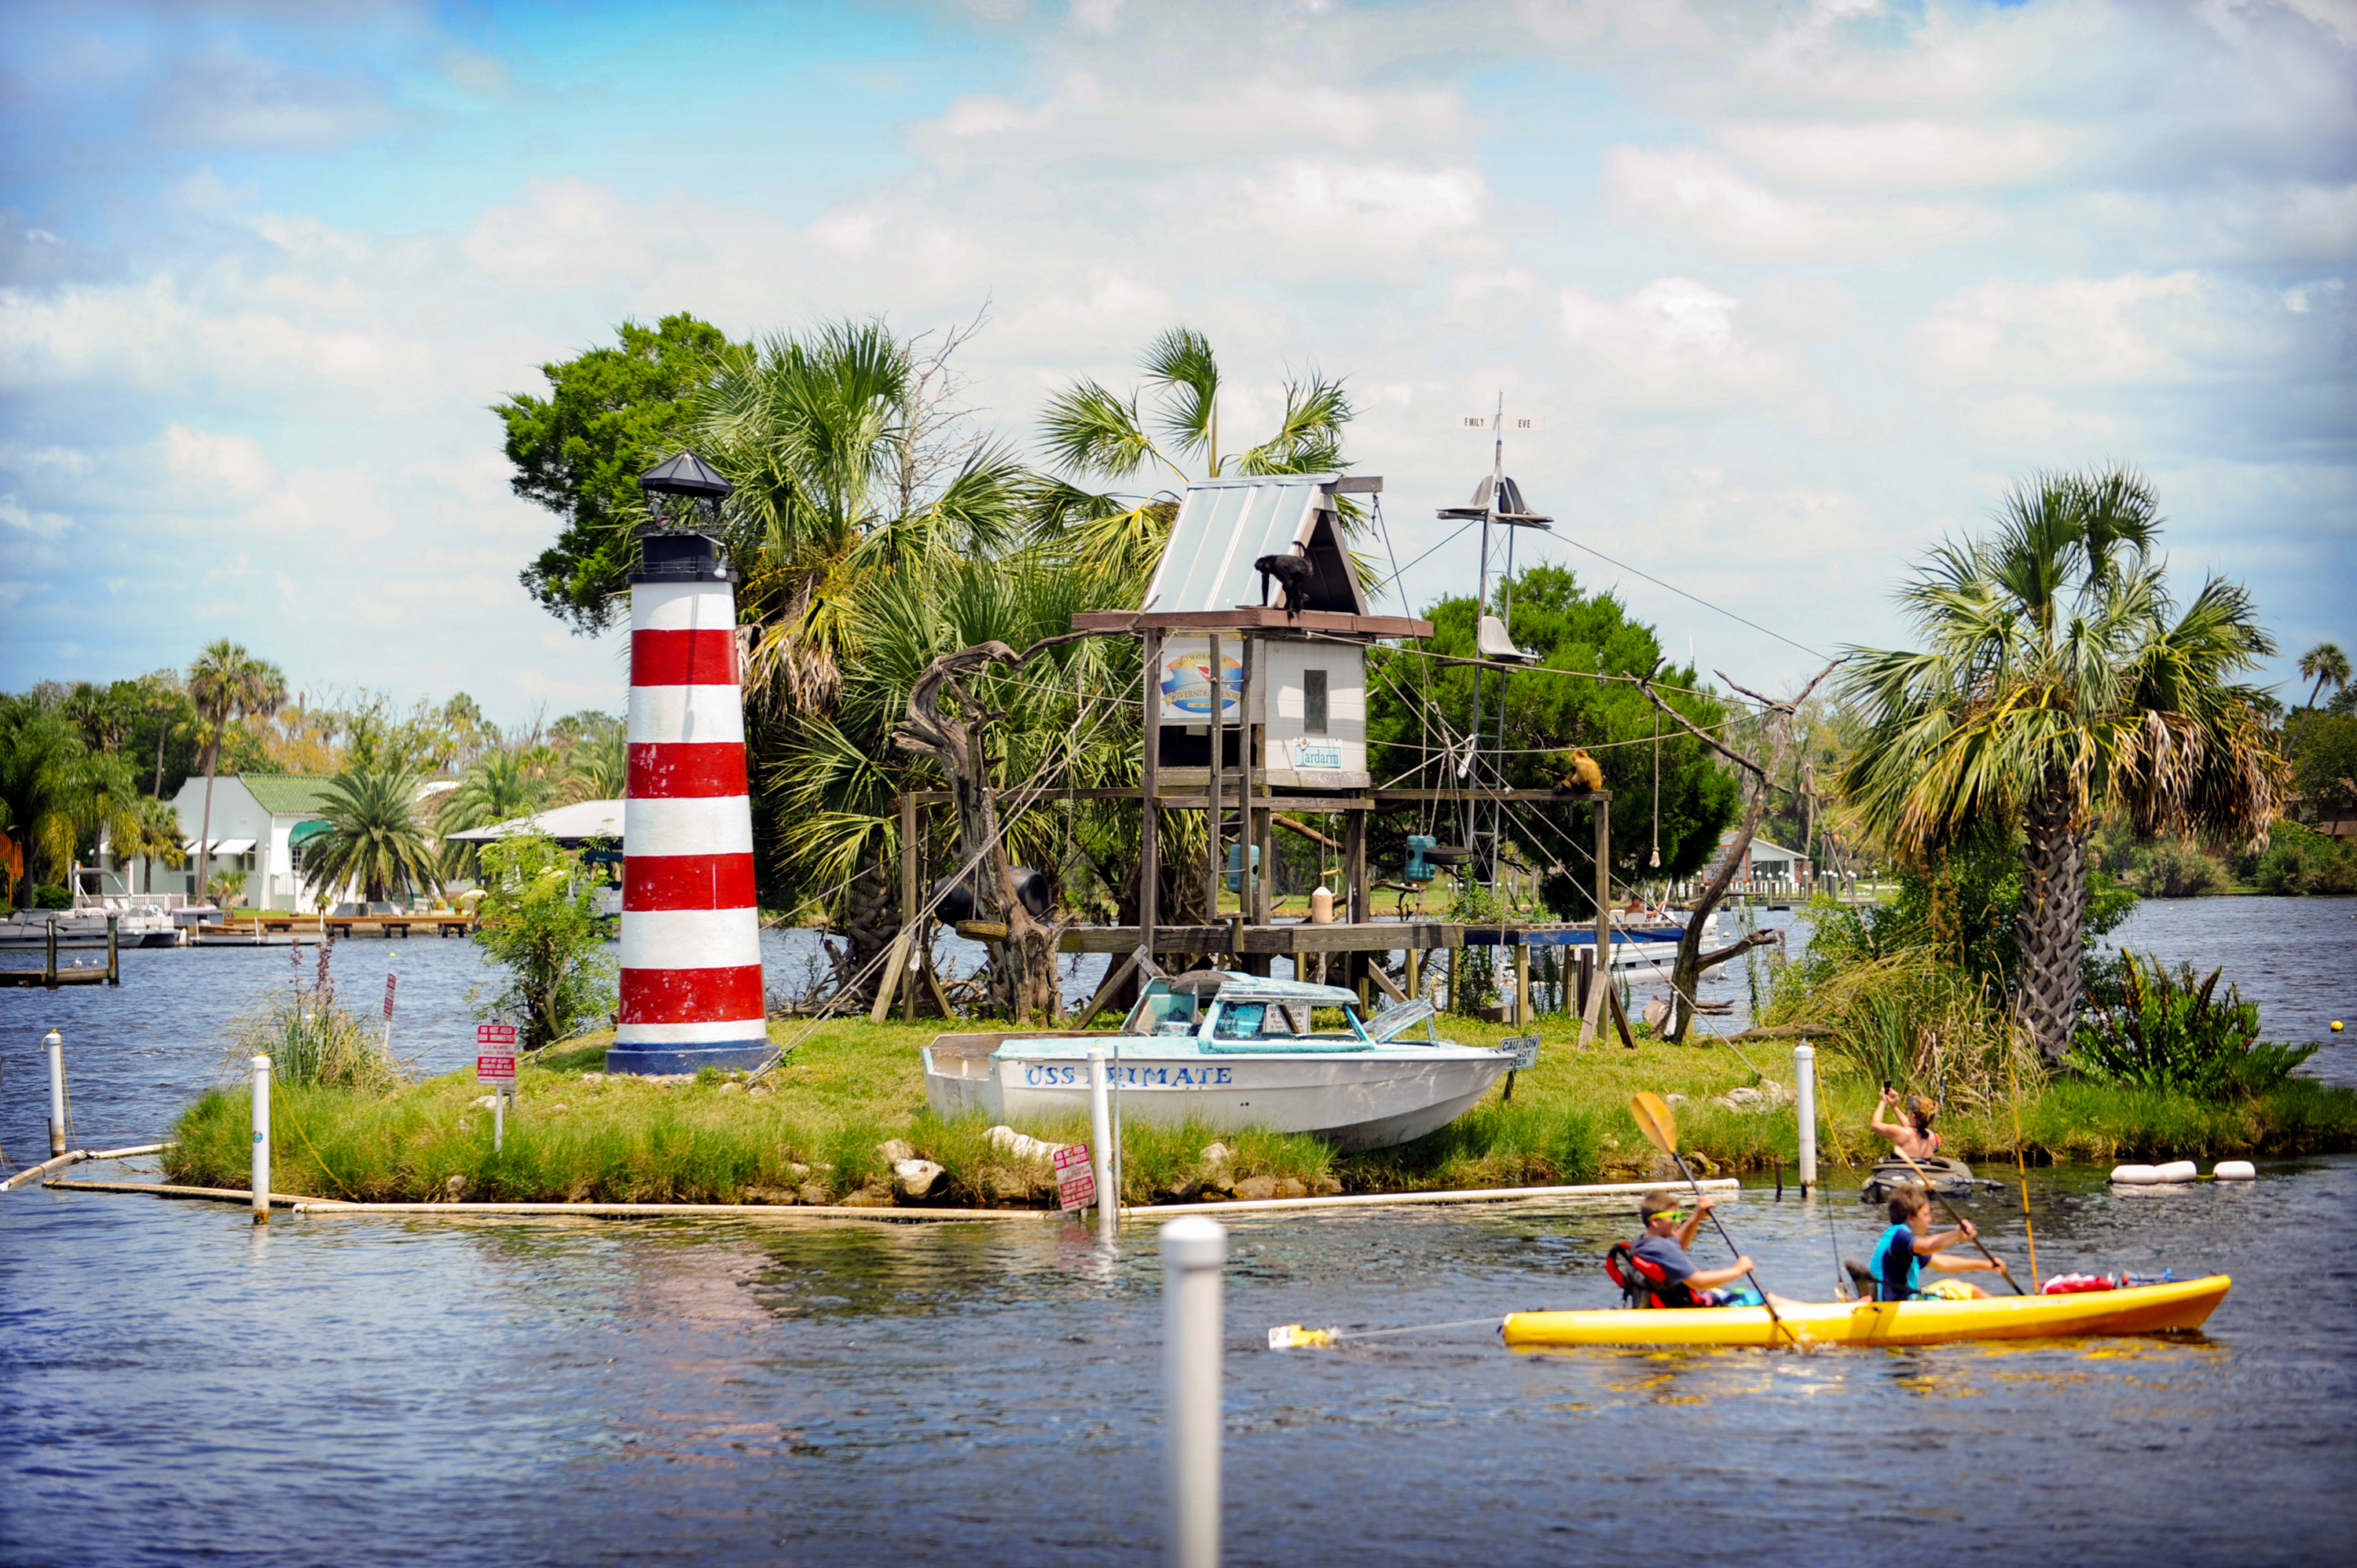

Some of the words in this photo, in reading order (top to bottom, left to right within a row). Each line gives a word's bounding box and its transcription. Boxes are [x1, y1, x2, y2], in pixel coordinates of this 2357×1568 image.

[1464, 417, 1484, 427] EMILY
[1518, 419, 1530, 428] EVE
[1172, 690, 1208, 701] RIVERSIDE
[1025, 1064, 1075, 1086] USS
[1086, 1067, 1233, 1087] RIMATE
